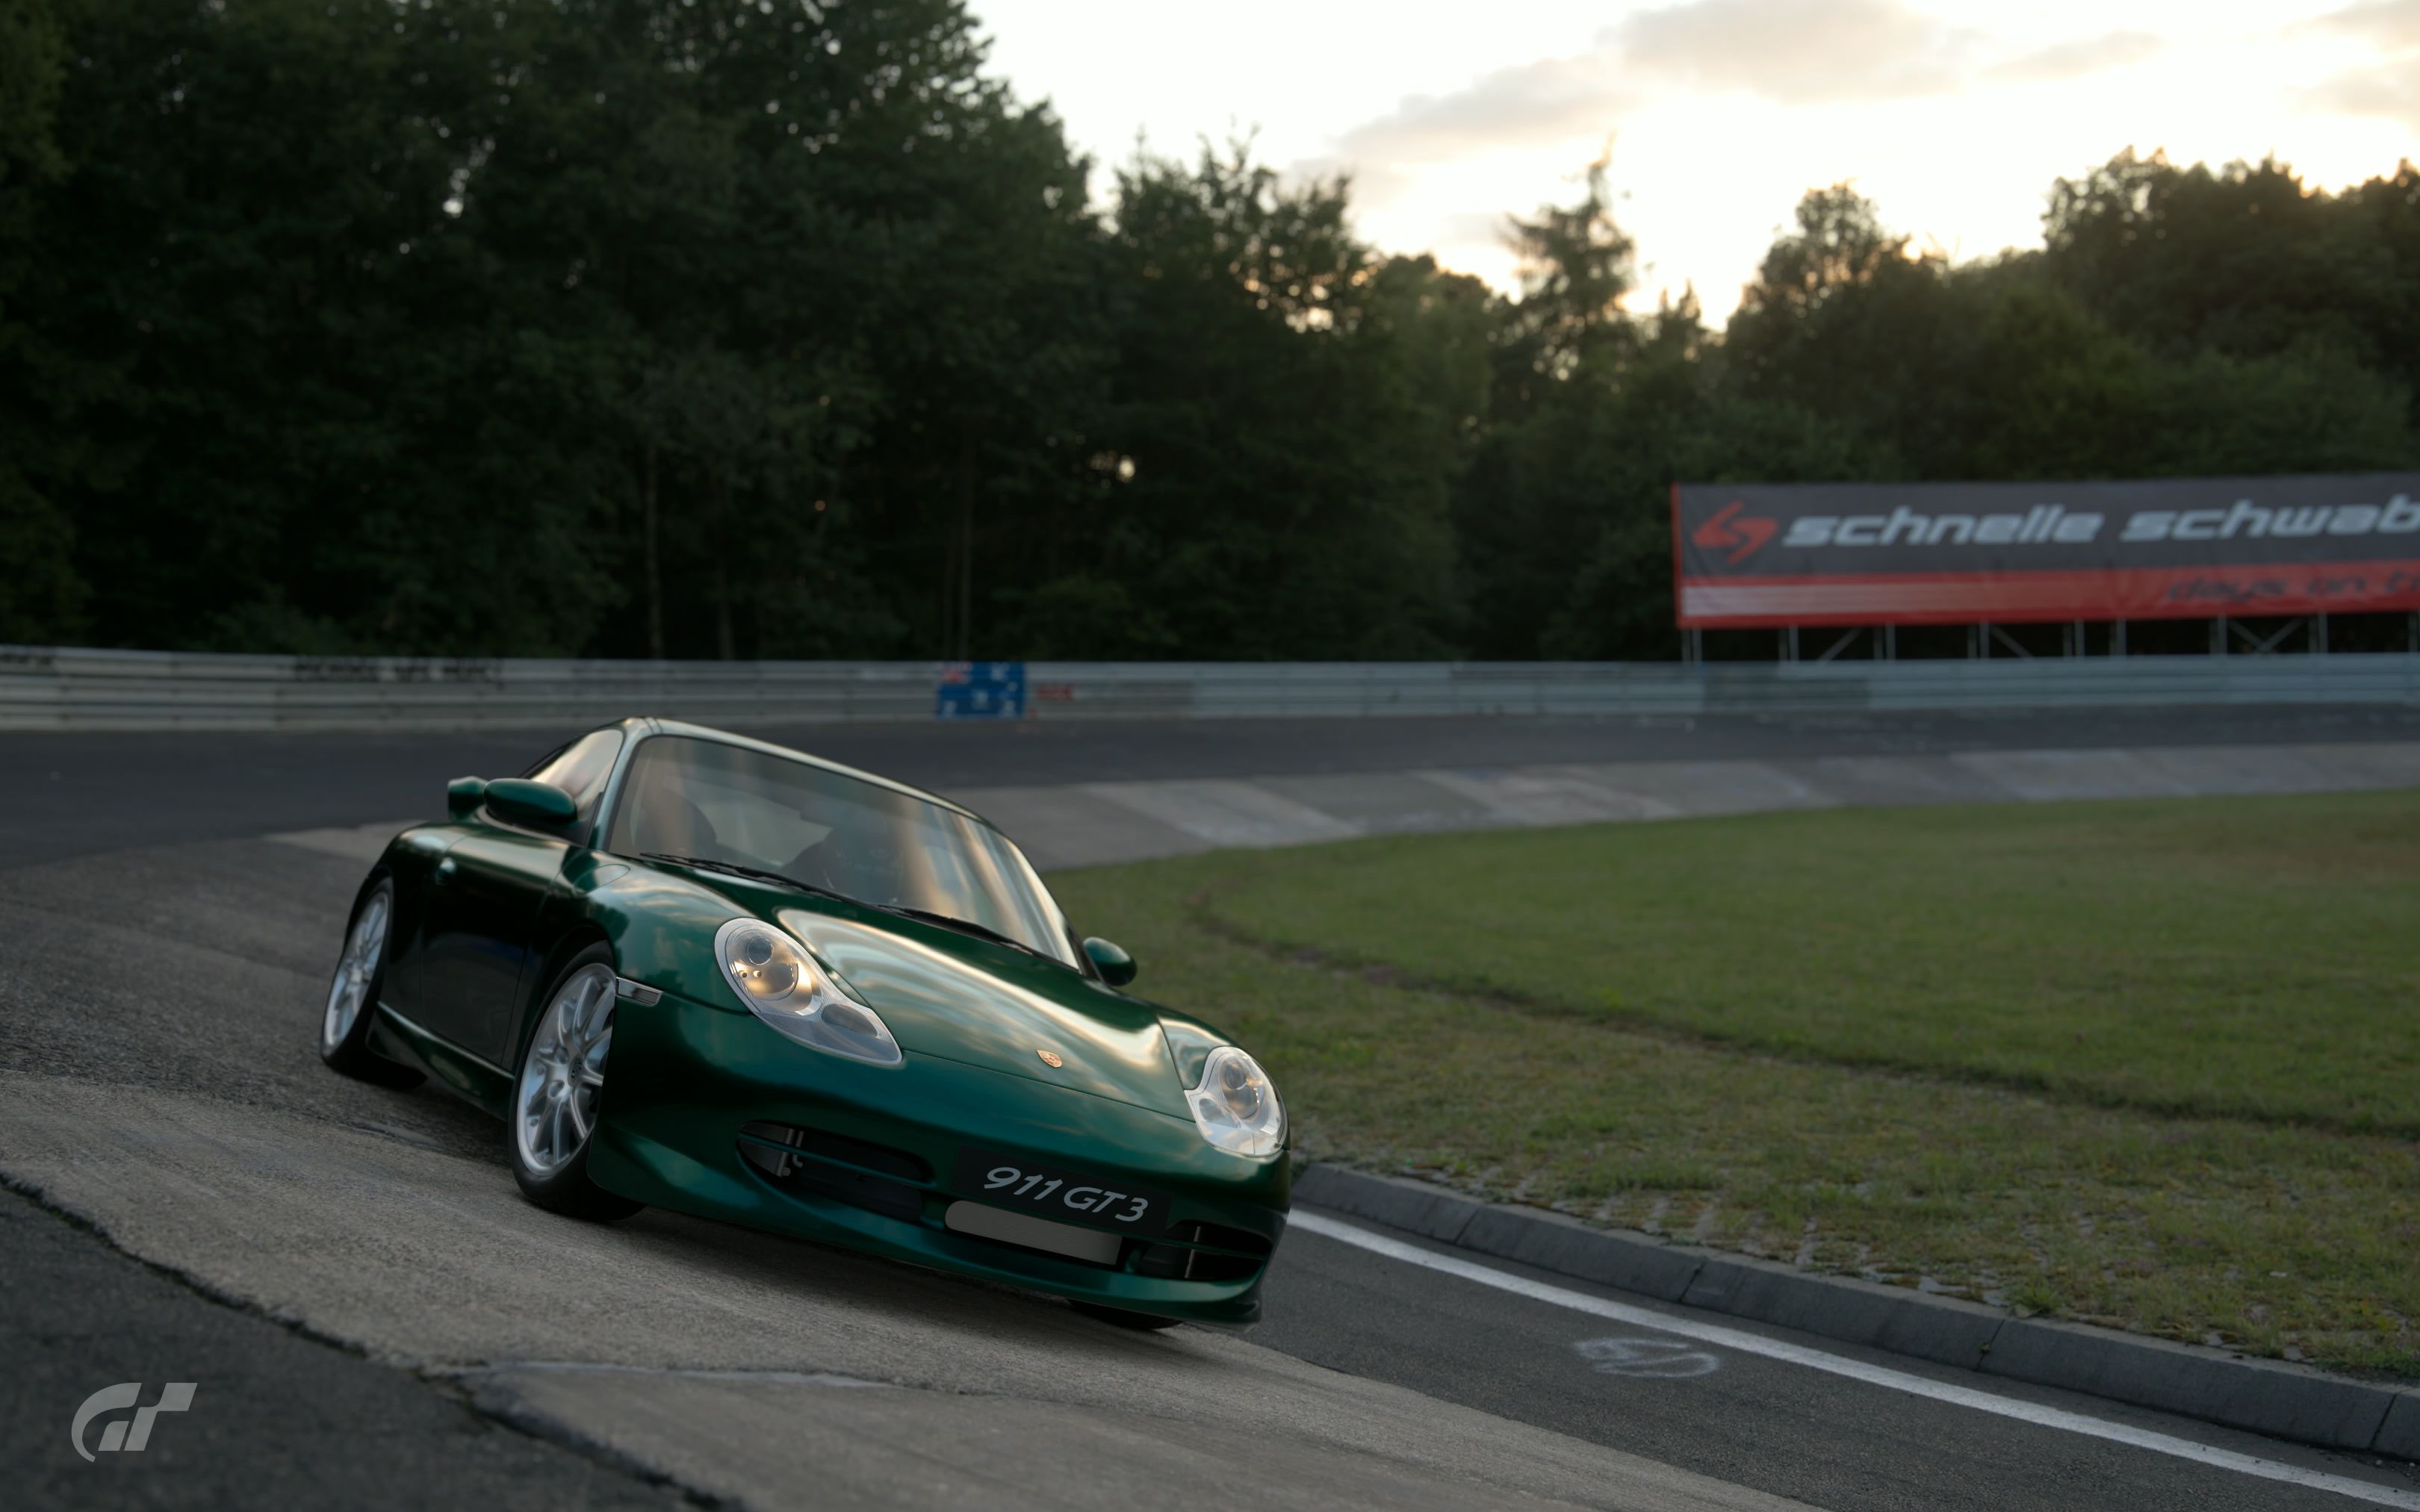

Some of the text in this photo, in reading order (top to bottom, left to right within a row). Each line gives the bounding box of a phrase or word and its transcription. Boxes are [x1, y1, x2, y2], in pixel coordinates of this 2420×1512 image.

[1780, 494, 2420, 545] schnelle schwab
[983, 1166, 1064, 1201] 911
